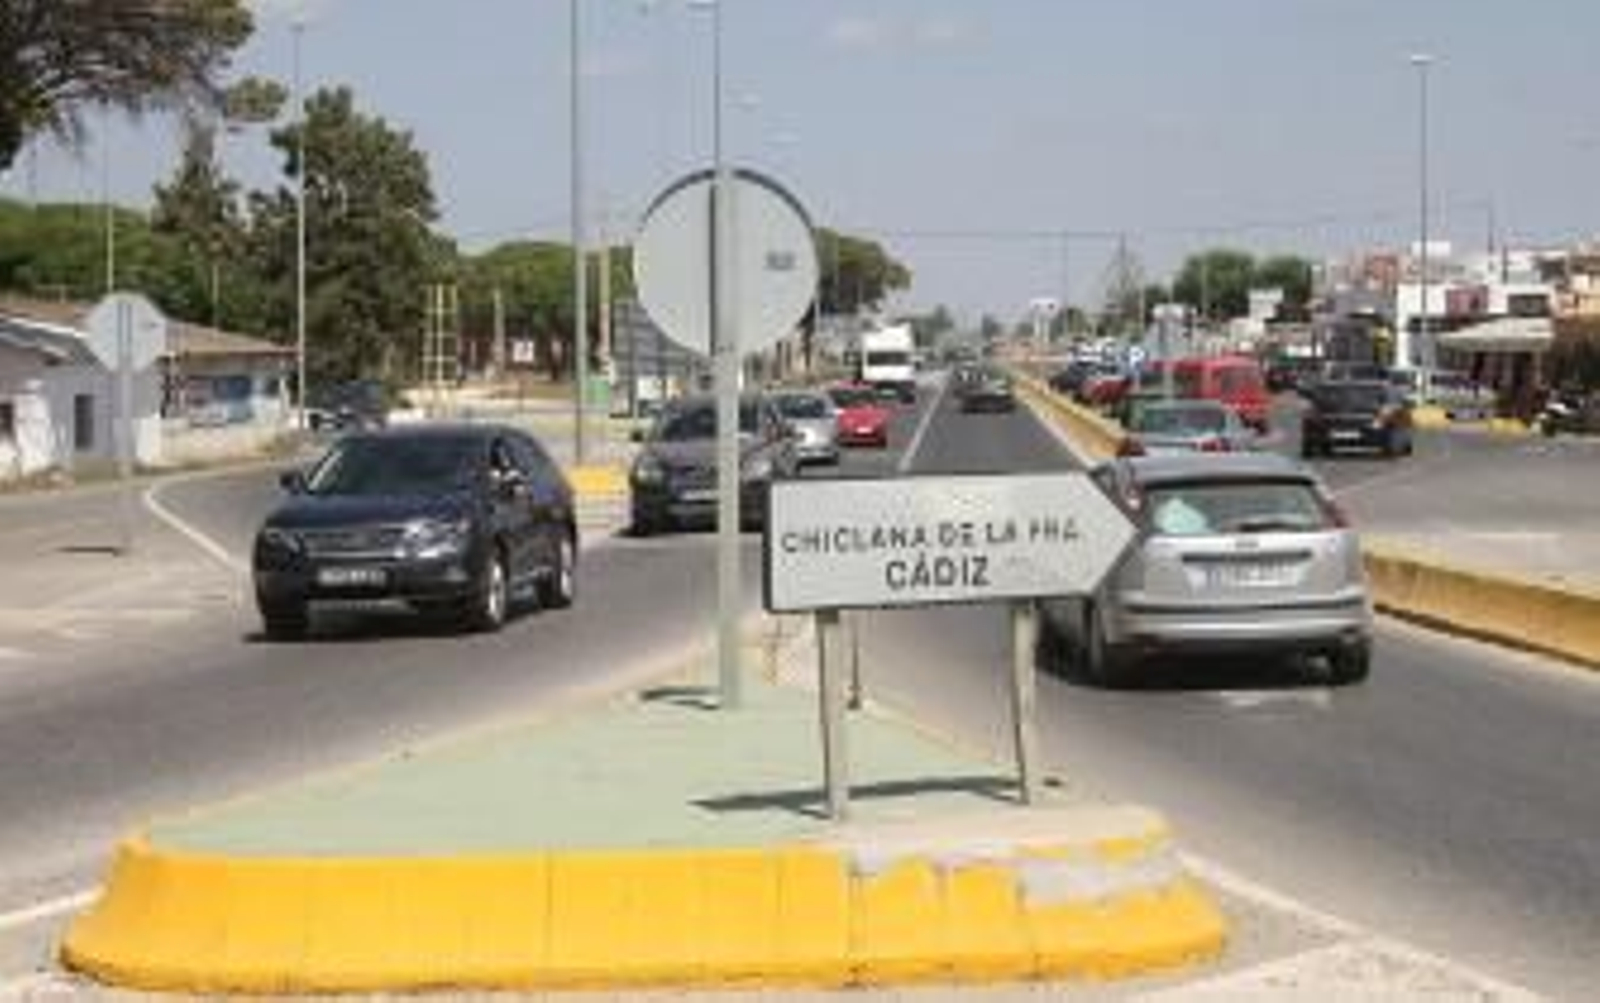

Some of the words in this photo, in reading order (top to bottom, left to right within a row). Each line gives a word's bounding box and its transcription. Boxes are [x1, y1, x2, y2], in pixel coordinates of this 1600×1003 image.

[781, 527, 931, 553] CHICLANA
[938, 521, 975, 548] DE
[986, 518, 1017, 543] LA
[885, 552, 992, 590] CÁDIZ
